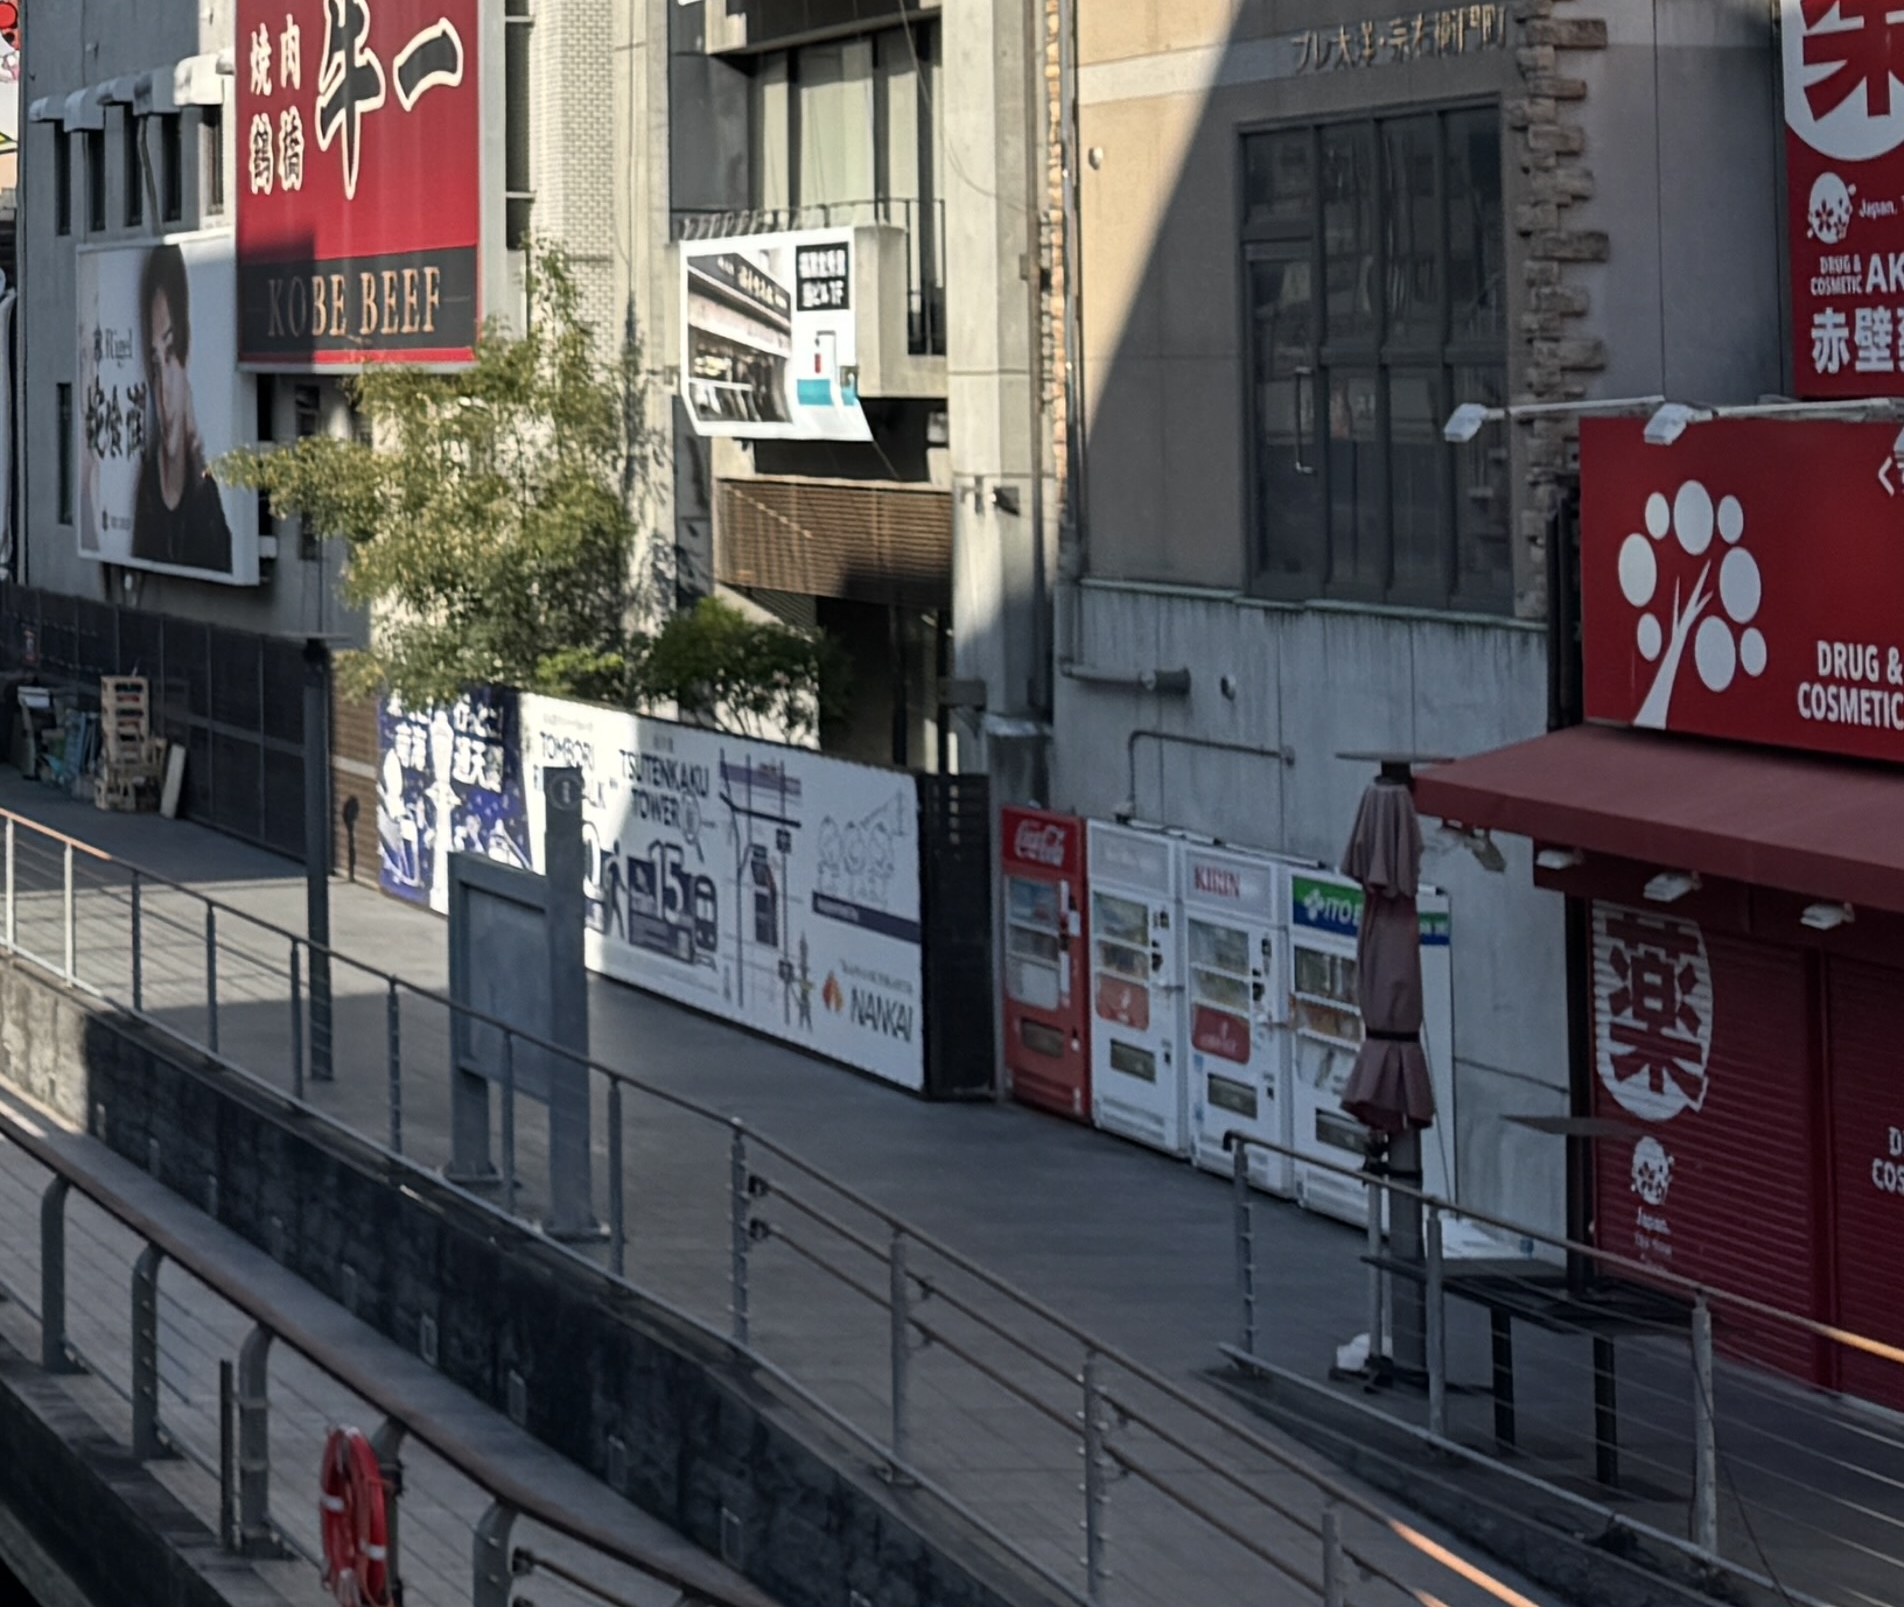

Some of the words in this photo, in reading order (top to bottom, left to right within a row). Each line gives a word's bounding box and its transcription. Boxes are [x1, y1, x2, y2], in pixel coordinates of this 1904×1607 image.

[1810, 272, 1863, 296] COSMETIC
[1820, 254, 1852, 275] DRUG
[267, 273, 347, 338] KOBE
[359, 265, 441, 334] BEEF
[1810, 305, 1904, 375] 赤壁
[1817, 639, 1880, 684] DRUG
[1797, 681, 1904, 732] COSMETIC
[1194, 866, 1241, 900] KIRIN
[850, 985, 914, 1045] NANKAI
